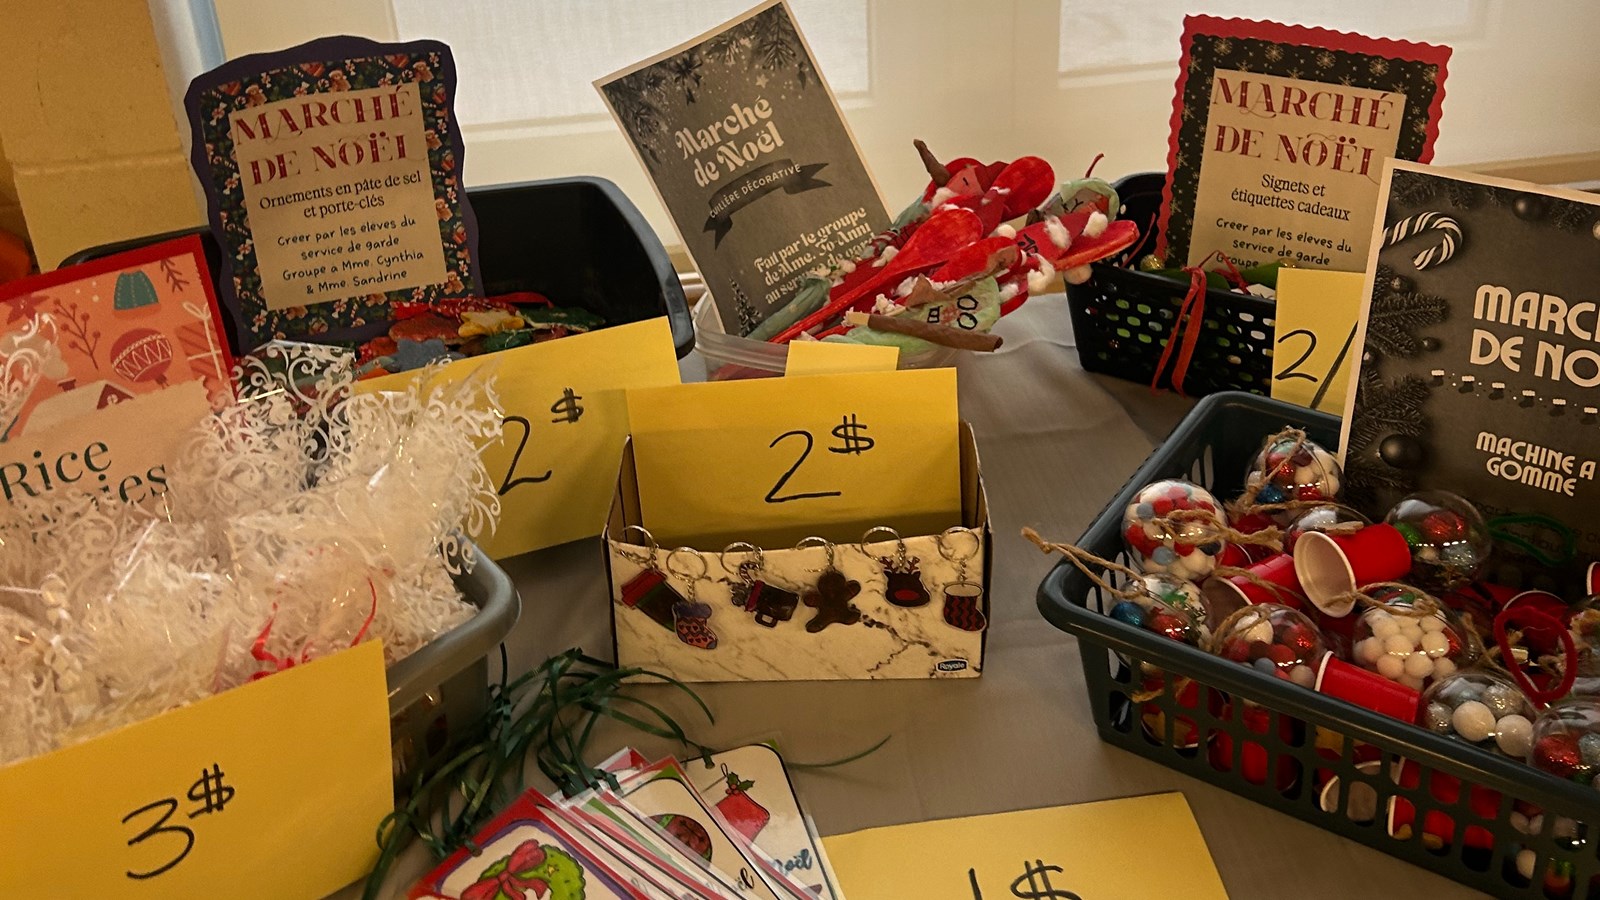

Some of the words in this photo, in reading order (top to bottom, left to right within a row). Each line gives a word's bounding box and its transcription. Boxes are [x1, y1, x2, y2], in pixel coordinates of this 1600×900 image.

[234, 85, 414, 146] MARCHÉ
[1213, 77, 1394, 130] MARCHÉ
[675, 95, 773, 160] Marché
[250, 150, 300, 186] DE
[312, 131, 426, 172] NOËL
[694, 158, 720, 188] de
[716, 121, 785, 172] Noël
[1214, 124, 1264, 158] DE
[1275, 133, 1378, 183] NOËL
[259, 186, 333, 210] Ornements
[335, 183, 352, 196] en
[354, 178, 383, 197] pâte
[385, 174, 401, 188] de
[403, 170, 422, 185] sel
[709, 190, 741, 219] CUILLÈRE
[741, 163, 802, 195] DÉCORATIVE
[1231, 188, 1295, 211] étiquettes
[1297, 201, 1351, 221] cadeaux
[1261, 173, 1310, 194] Signets
[1312, 183, 1326, 197] et
[303, 205, 318, 219] et
[320, 193, 385, 220] porte-clés
[277, 232, 311, 247] Creer
[315, 228, 335, 244] par
[340, 223, 357, 237] les
[360, 218, 397, 233] eleves
[400, 214, 417, 227] du
[301, 246, 343, 261] service
[347, 240, 362, 253] de
[365, 235, 400, 254] garde
[754, 251, 779, 273] Fait
[778, 240, 800, 261] par
[800, 232, 817, 247] le
[817, 207, 867, 243] groupe
[1216, 217, 1248, 231] Creer
[1252, 226, 1273, 238] par
[1276, 227, 1293, 241] les
[1297, 232, 1333, 249] eleves
[1337, 238, 1352, 253] du
[283, 266, 326, 282] Groupe
[330, 263, 339, 274] a
[377, 250, 424, 269] Cynthia
[1233, 239, 1274, 254] service
[1277, 245, 1292, 257] de
[1296, 249, 1330, 266] garde
[306, 284, 315, 295] &
[353, 268, 408, 287] Sandrine
[765, 271, 780, 287] de
[765, 289, 781, 304] au
[1473, 284, 1600, 343] MARC
[1469, 328, 1524, 373] DE
[1534, 340, 1600, 388] NO
[0, 441, 112, 501] Rice
[1476, 431, 1576, 475] MACHINE
[1579, 460, 1596, 480] A
[1486, 457, 1577, 497] GOMME
[939, 661, 965, 670] Royale
